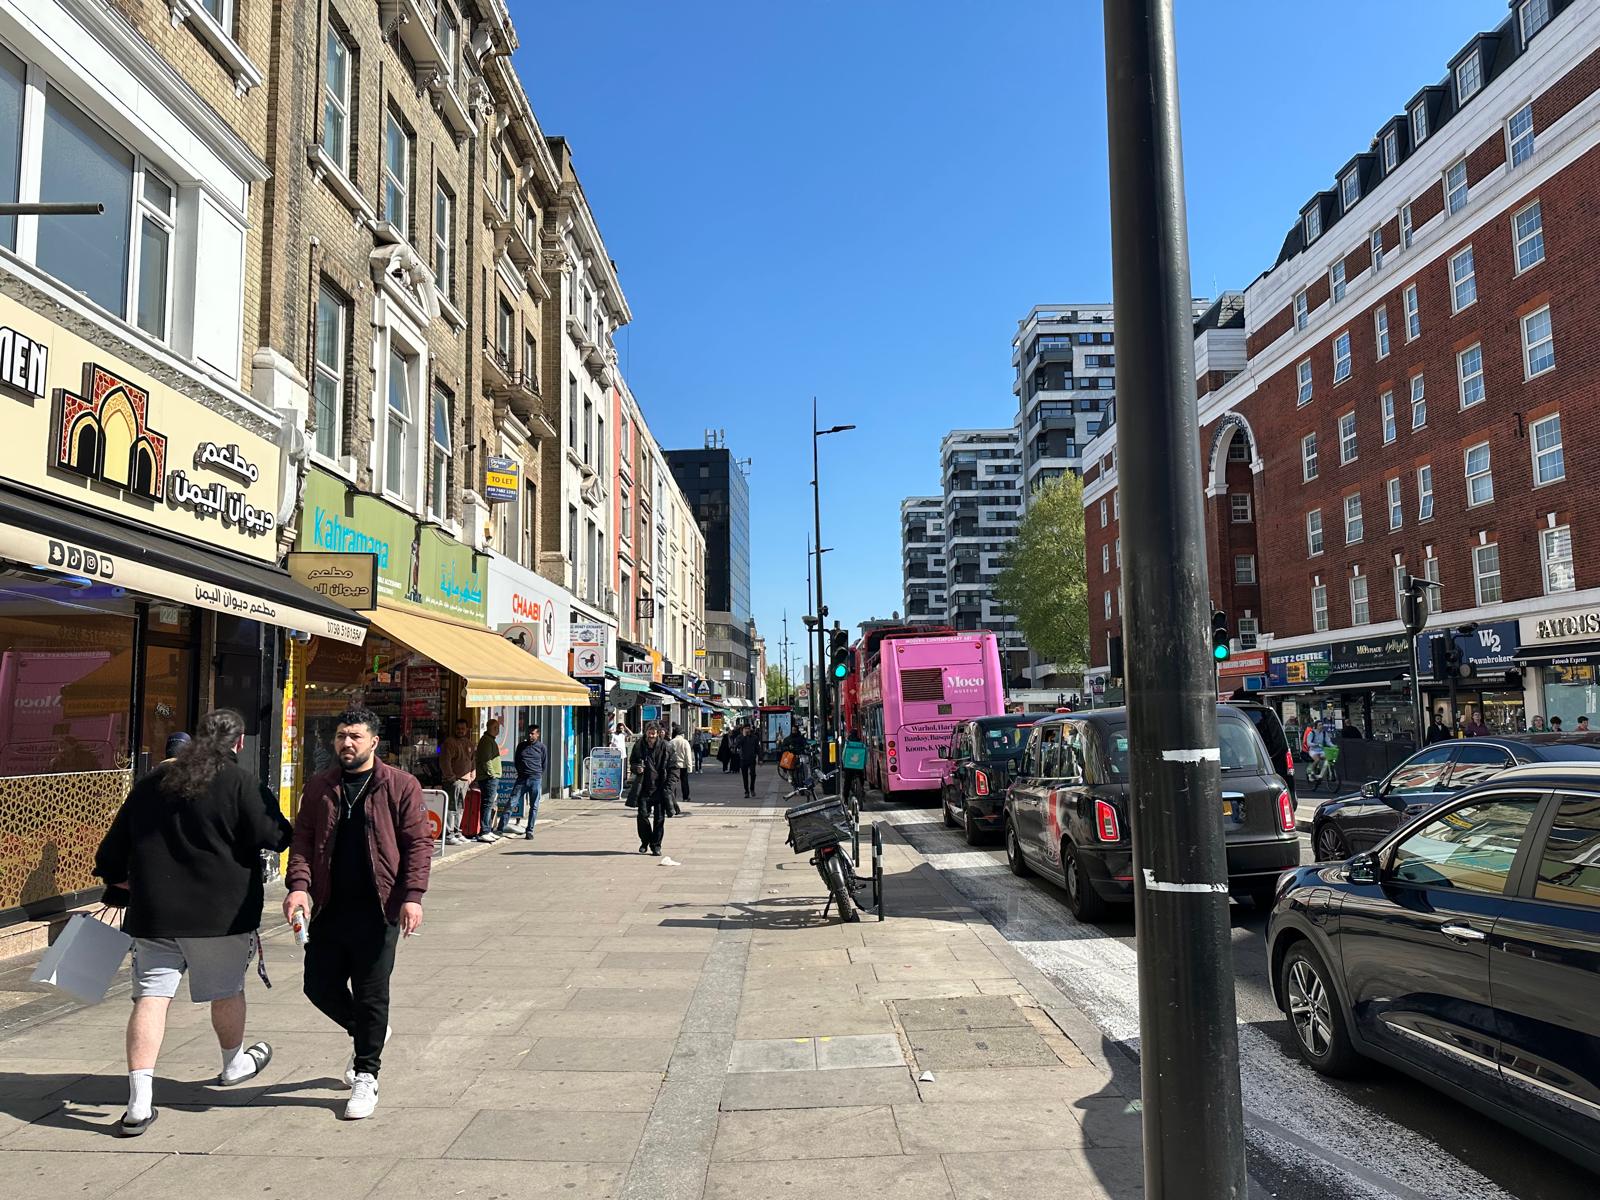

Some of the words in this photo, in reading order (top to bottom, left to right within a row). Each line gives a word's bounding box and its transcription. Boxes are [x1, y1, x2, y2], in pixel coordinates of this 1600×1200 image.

[201, 442, 258, 482] مطعم
[174, 469, 227, 512] اليمن
[228, 492, 275, 531] ديوان
[313, 506, 389, 569] Kahramana
[307, 566, 354, 580] مطعم
[194, 584, 221, 603] اليمن
[329, 583, 370, 597] ديوان
[223, 591, 249, 611] ديوان
[249, 602, 276, 618] مطعم
[512, 593, 541, 622] CHAABI
[1535, 613, 1600, 638] FATOUS
[1477, 629, 1502, 652] W2
[1271, 655, 1289, 664] WEST
[1290, 655, 1296, 663] 2
[1296, 651, 1324, 662] CENTRE
[1468, 655, 1514, 665] Pawnbrokers
[625, 664, 653, 673] TKM
[947, 676, 985, 688] Moco
